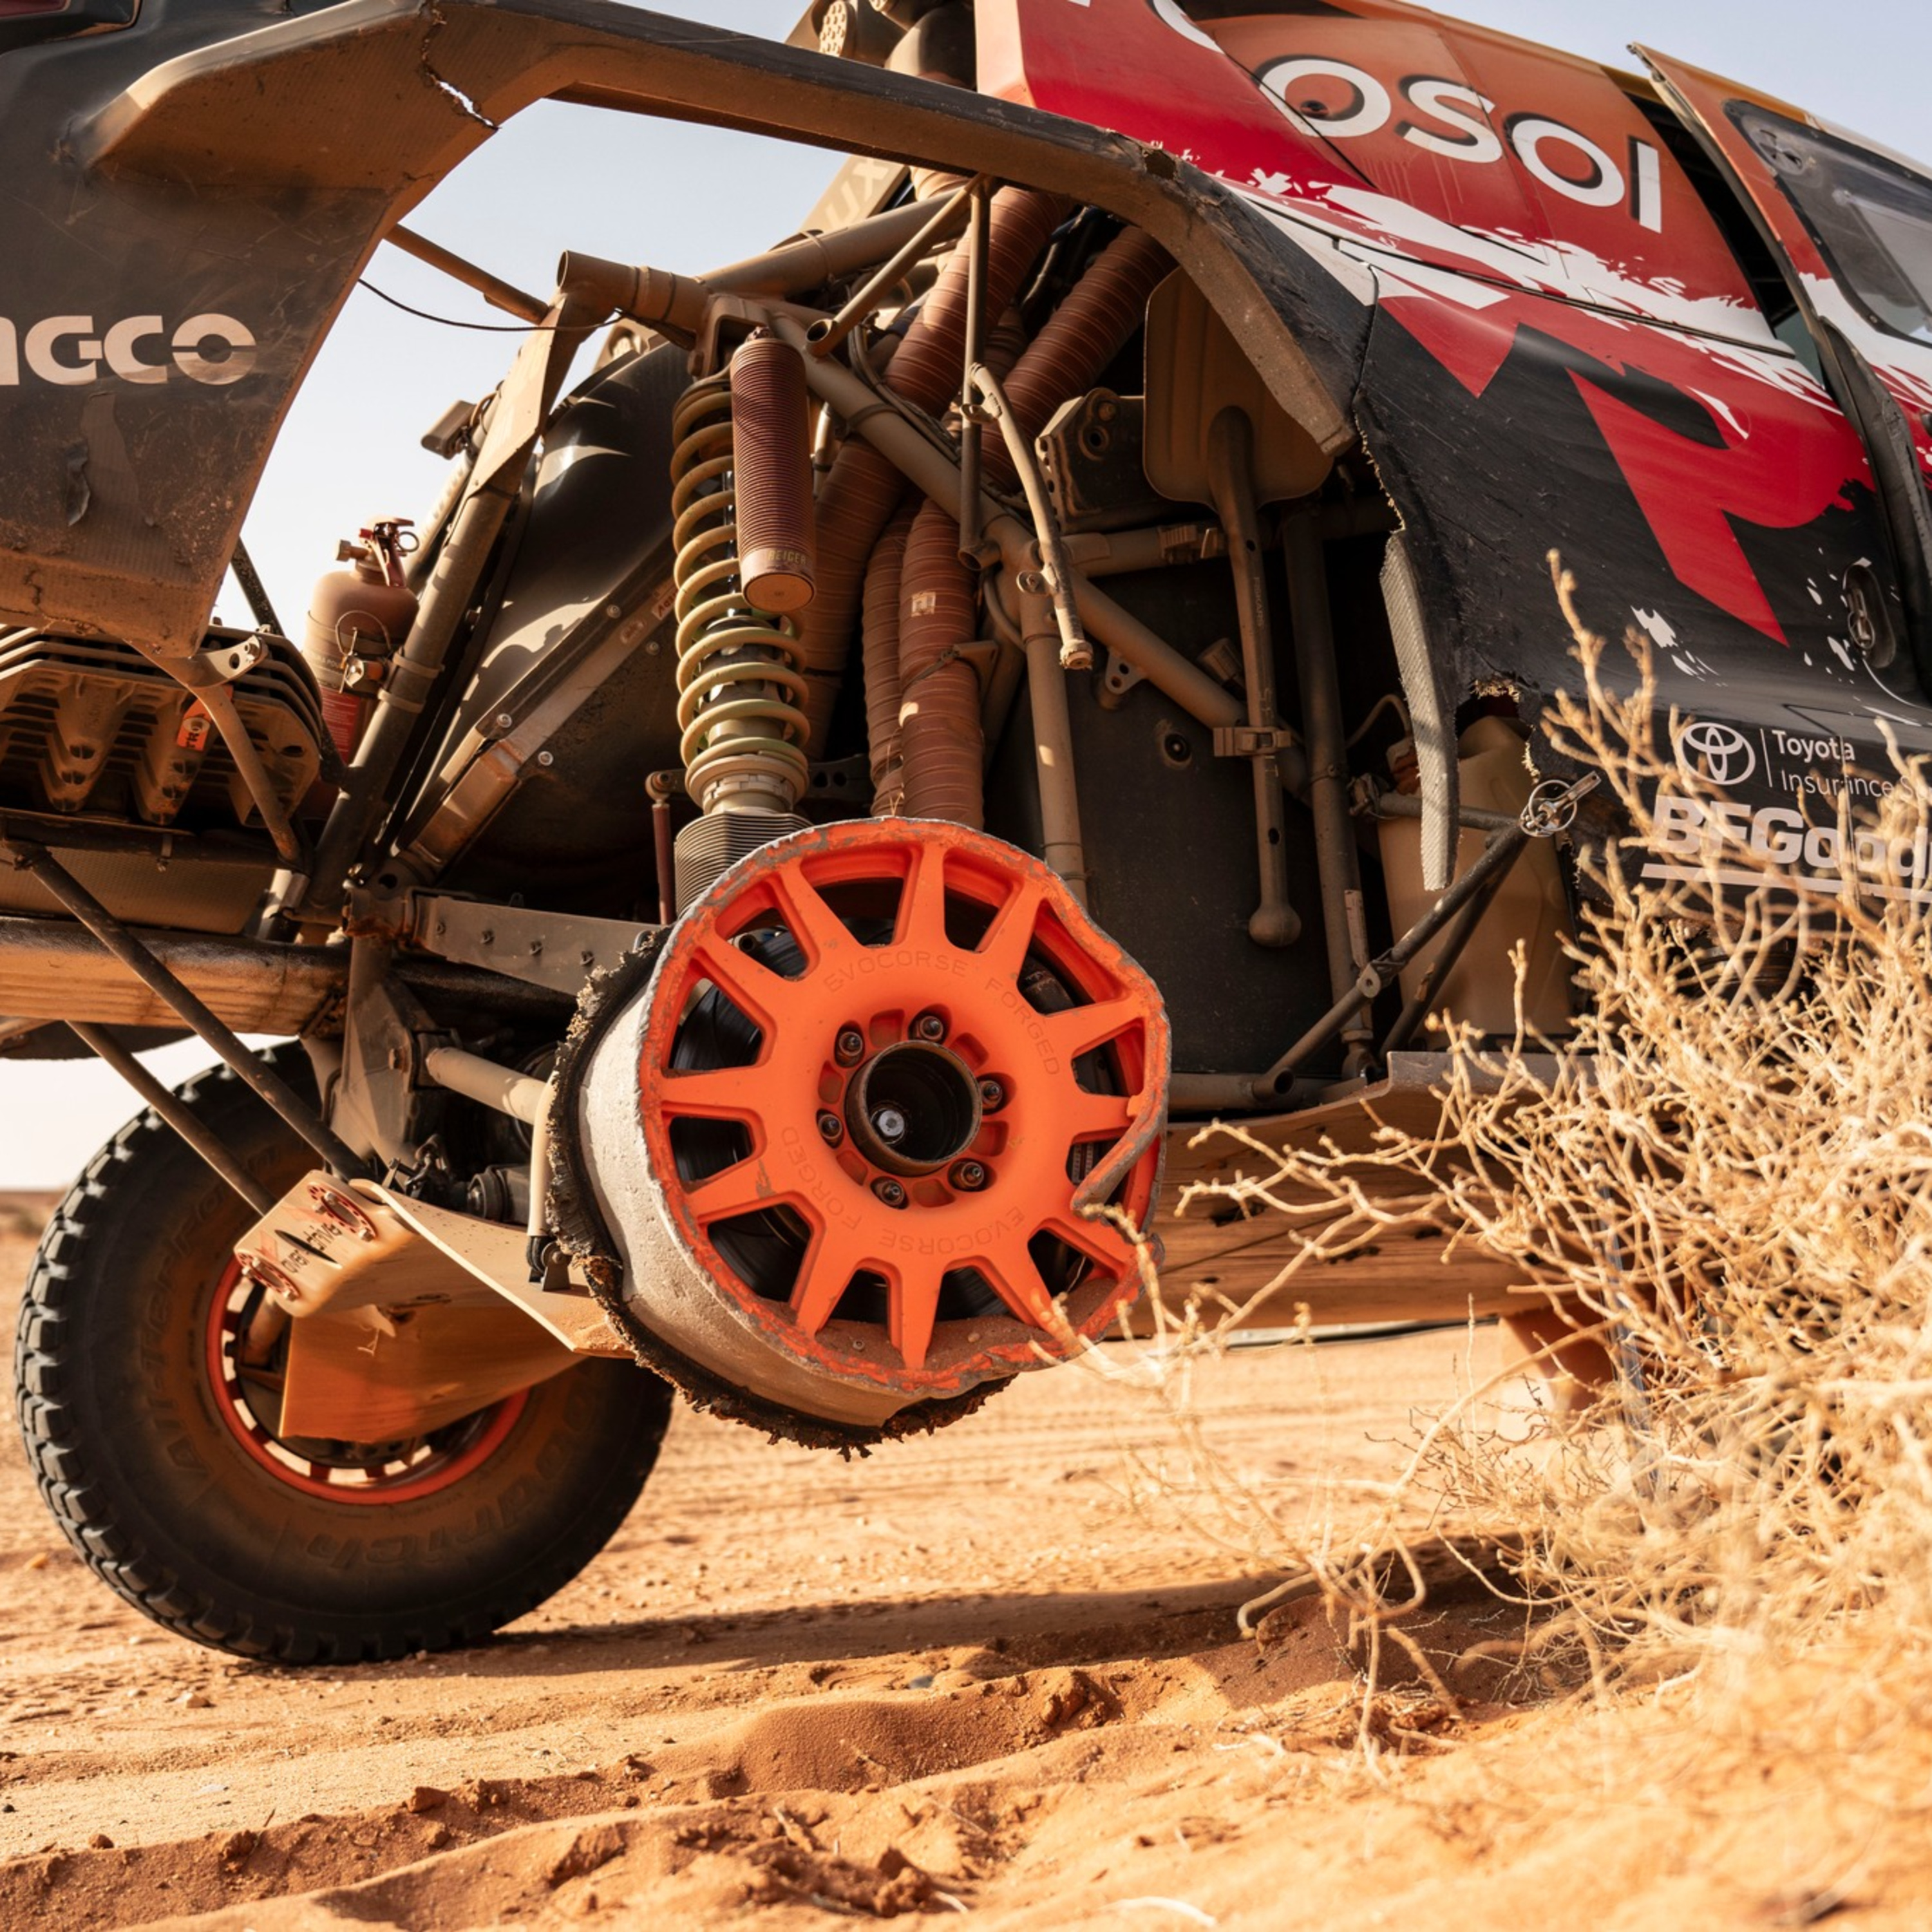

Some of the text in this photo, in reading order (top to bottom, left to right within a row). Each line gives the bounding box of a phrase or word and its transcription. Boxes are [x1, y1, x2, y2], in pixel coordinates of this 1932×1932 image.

[1772, 729, 1855, 763] Toyota
[1649, 795, 1932, 879] BFGood
[823, 950, 1060, 1075] EVOCORSE FORGED
[781, 1125, 1025, 1256] EVOCORSE FORGED
